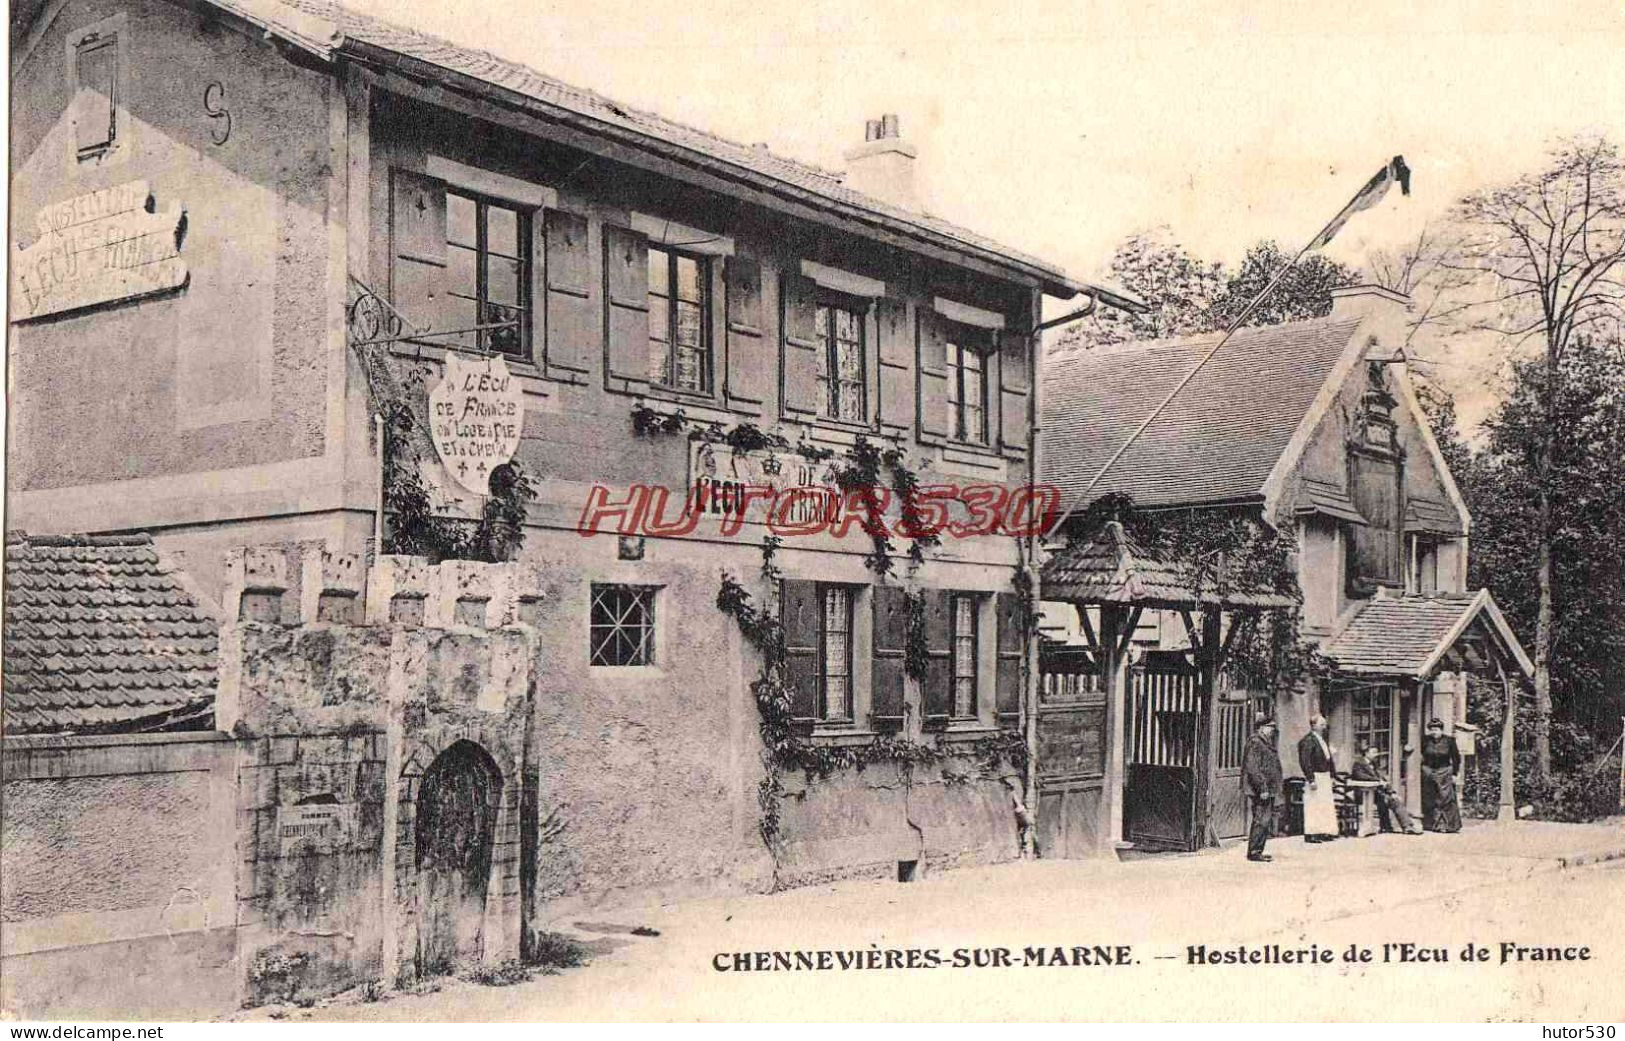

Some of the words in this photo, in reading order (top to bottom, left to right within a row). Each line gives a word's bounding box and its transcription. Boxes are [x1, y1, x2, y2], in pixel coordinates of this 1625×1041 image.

[462, 373, 510, 392] L'ECU
[436, 402, 454, 416] DE
[460, 396, 517, 422] FRANCE
[442, 441, 458, 455] ET
[798, 465, 817, 487] DE
[695, 477, 746, 515] L'ECU
